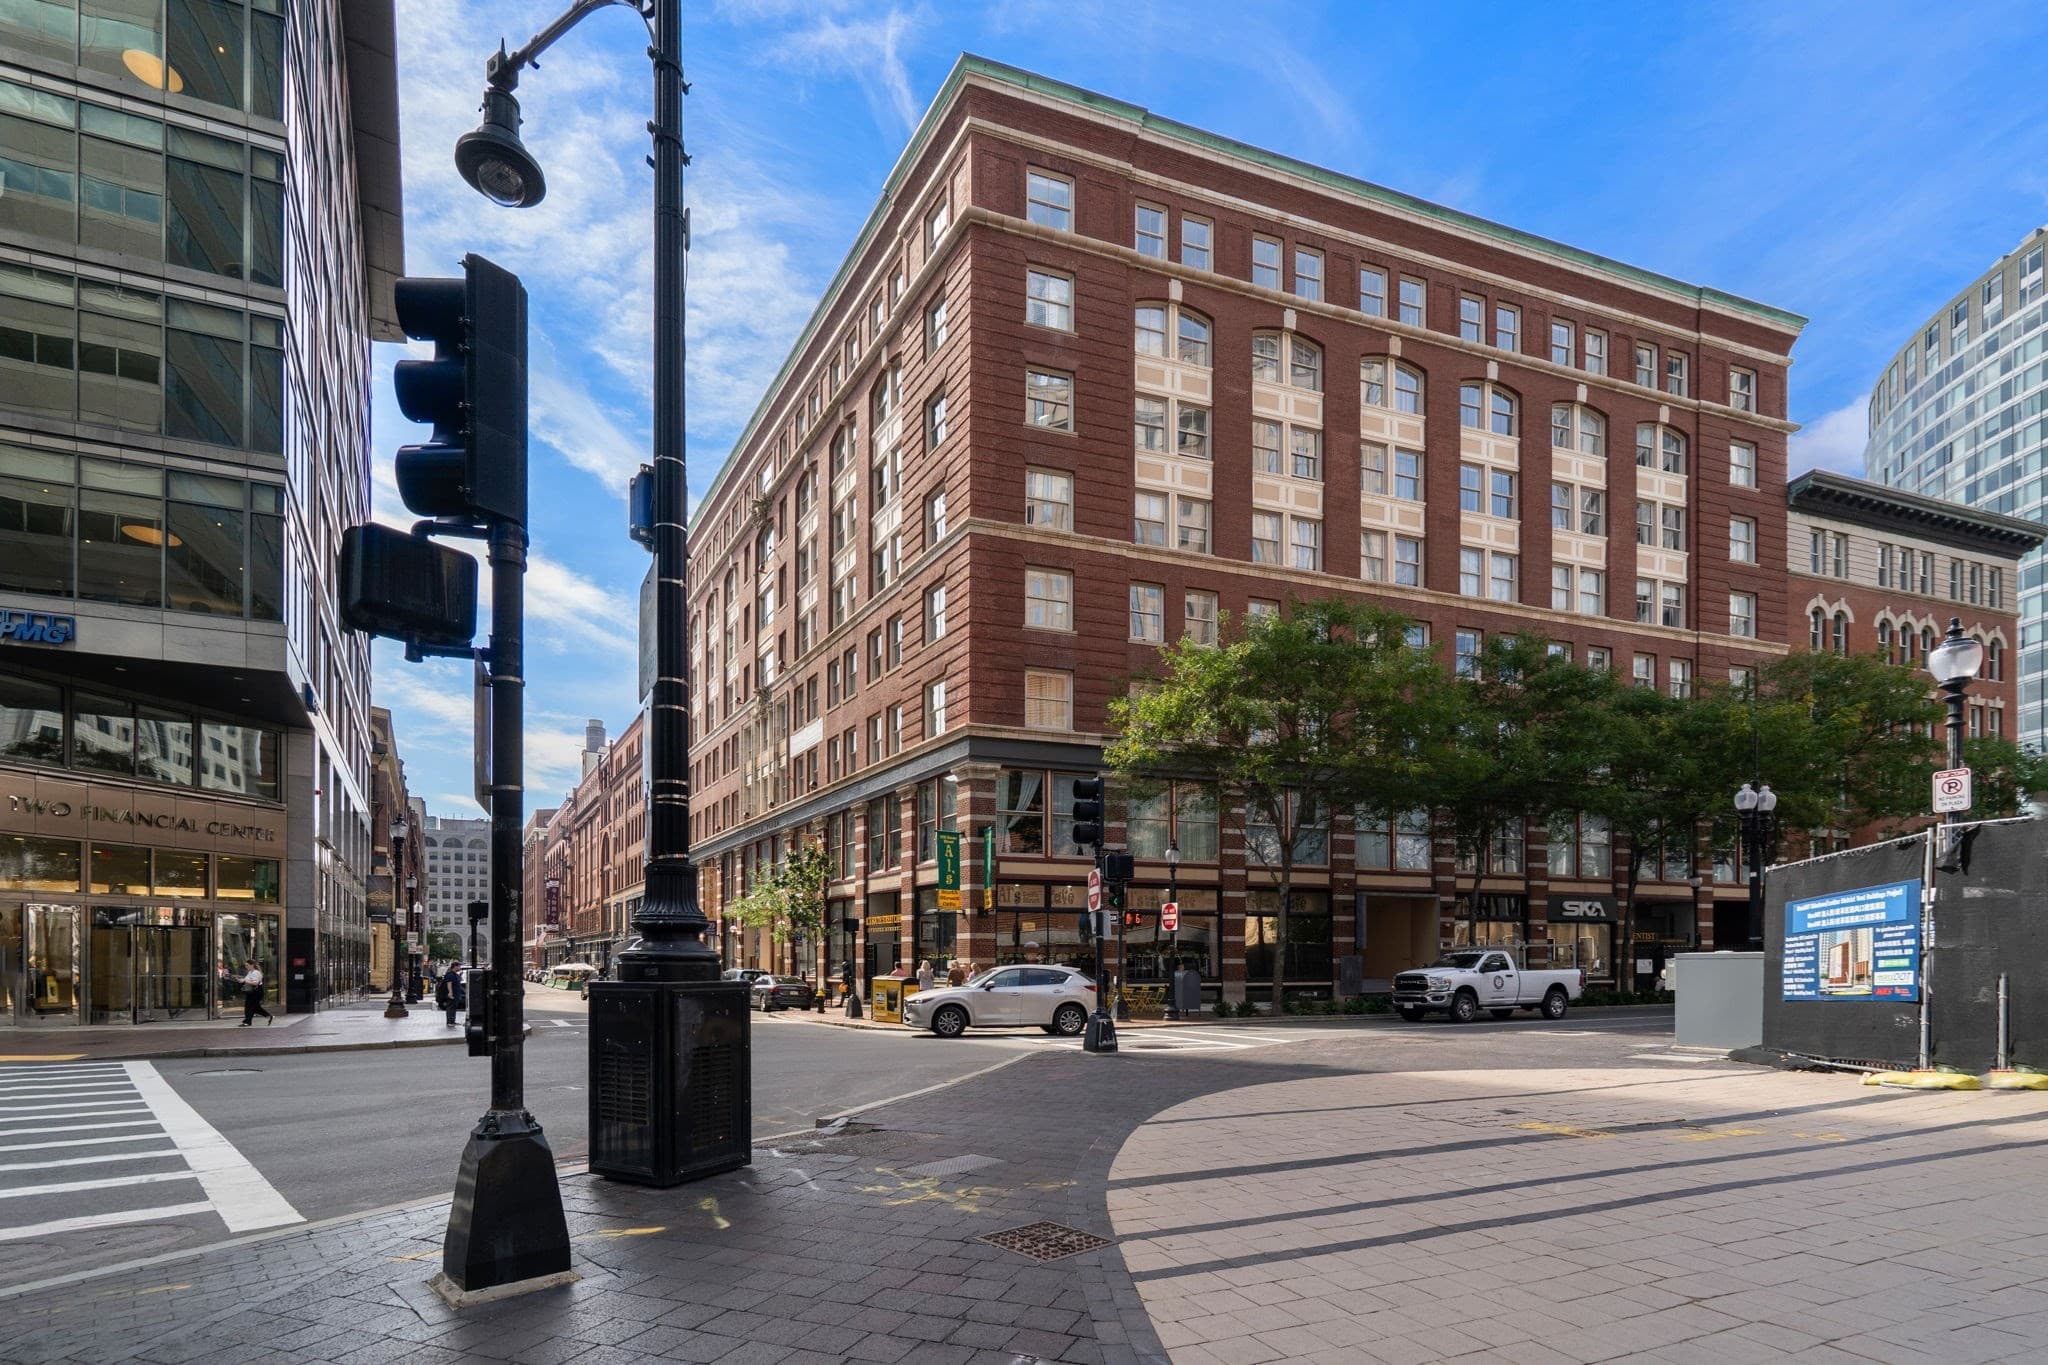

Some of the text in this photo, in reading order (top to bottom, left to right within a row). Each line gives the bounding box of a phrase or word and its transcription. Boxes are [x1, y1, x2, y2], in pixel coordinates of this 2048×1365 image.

[0, 622, 66, 644] PMG
[9, 795, 276, 842] TWO FINANCIAL CENTER
[1561, 900, 1606, 917] SKA
[1632, 931, 1656, 940] ENTIST
